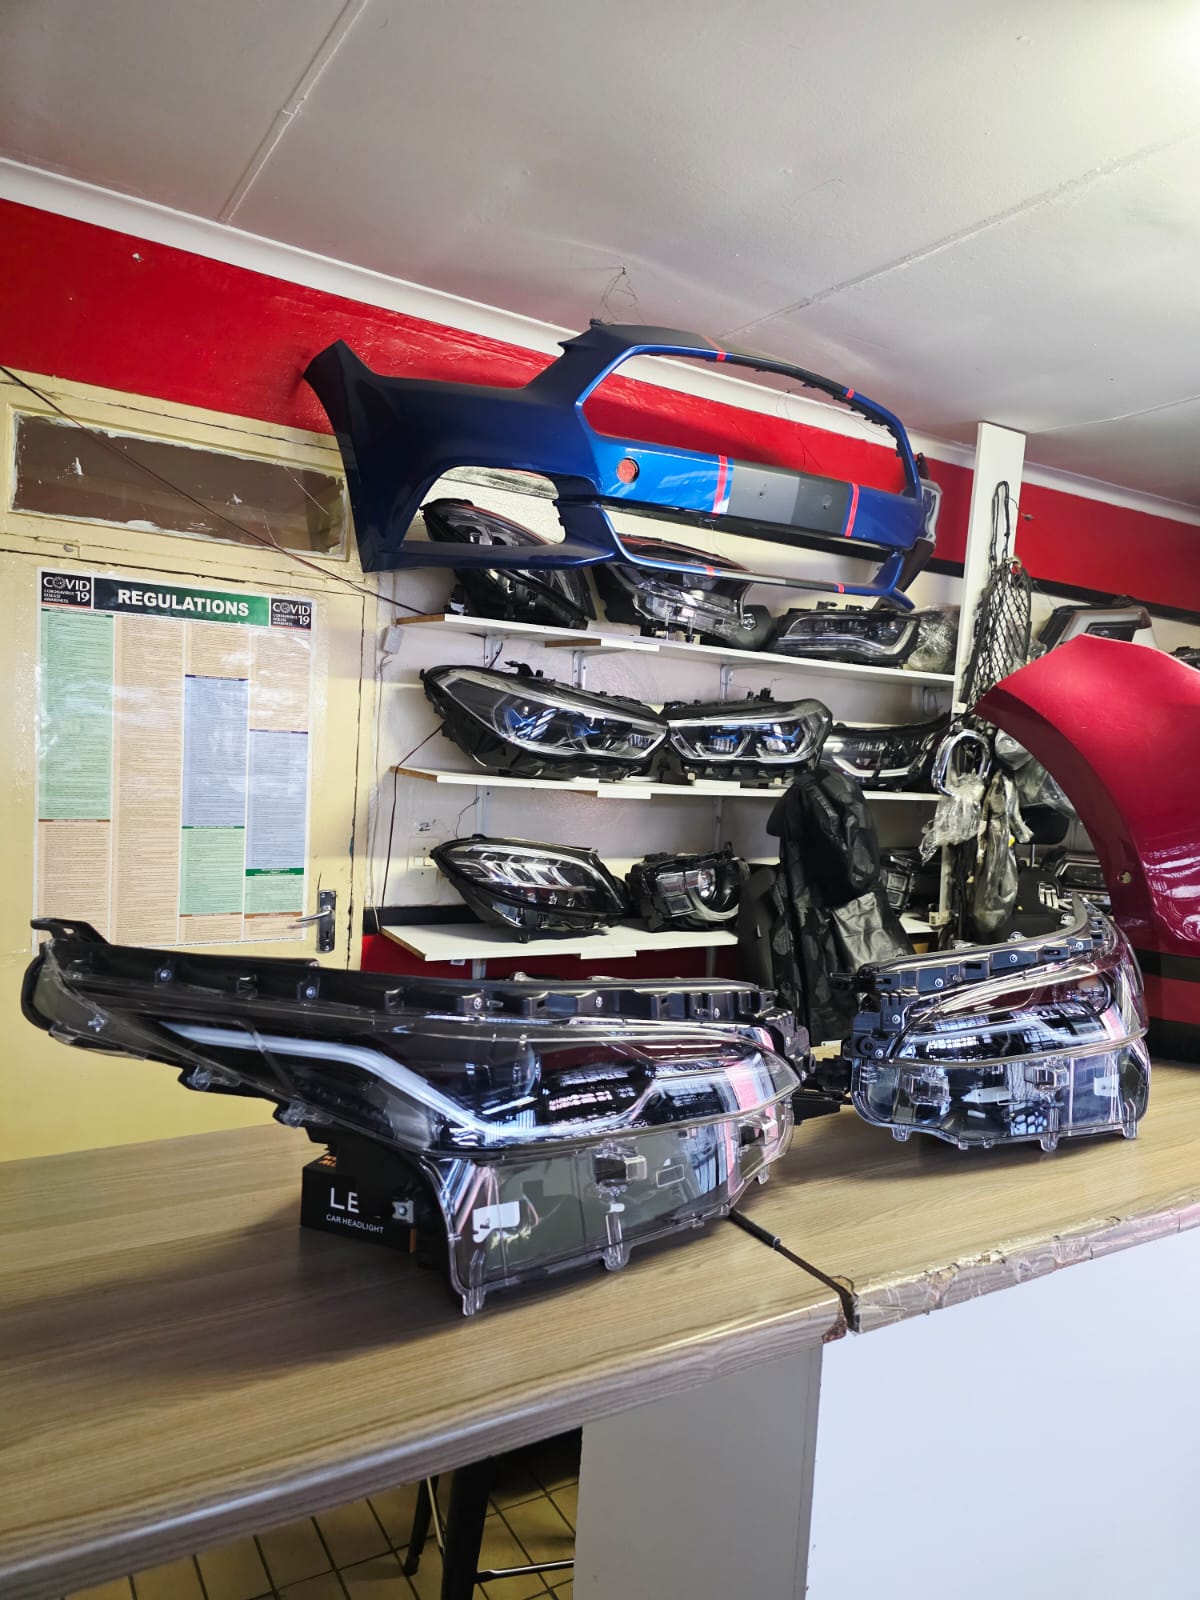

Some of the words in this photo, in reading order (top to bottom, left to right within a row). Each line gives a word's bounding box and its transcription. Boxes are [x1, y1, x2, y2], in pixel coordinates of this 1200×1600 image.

[43, 576, 90, 591] COVID
[75, 591, 90, 602] 19
[117, 589, 250, 617] REGULATIONS
[272, 602, 310, 615] COVID
[298, 615, 310, 625] 19
[330, 1187, 368, 1216] LE
[326, 1213, 342, 1224] CAR
[342, 1217, 384, 1234] HEADLIGHT
